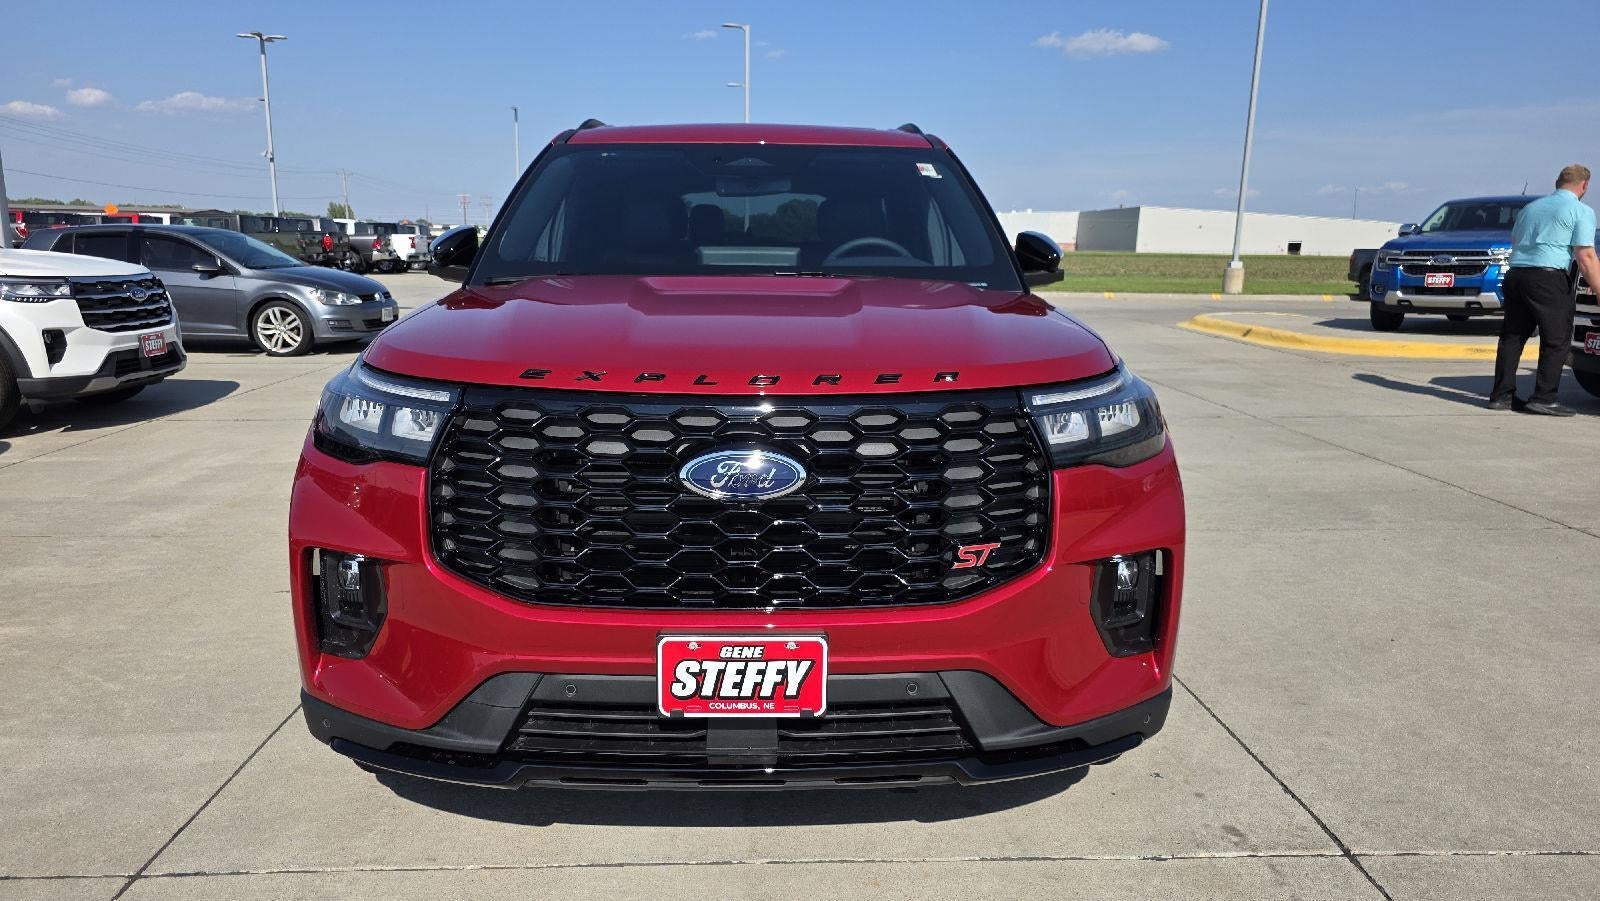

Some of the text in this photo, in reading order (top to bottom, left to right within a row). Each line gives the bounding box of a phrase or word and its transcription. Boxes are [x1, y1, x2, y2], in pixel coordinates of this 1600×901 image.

[519, 368, 960, 386] EXPLORER
[710, 460, 777, 488] Ford
[951, 542, 1001, 569] ST
[719, 645, 765, 658] GENE
[670, 659, 815, 699] STEFFY
[708, 702, 775, 711] COLUMBUS, NE
